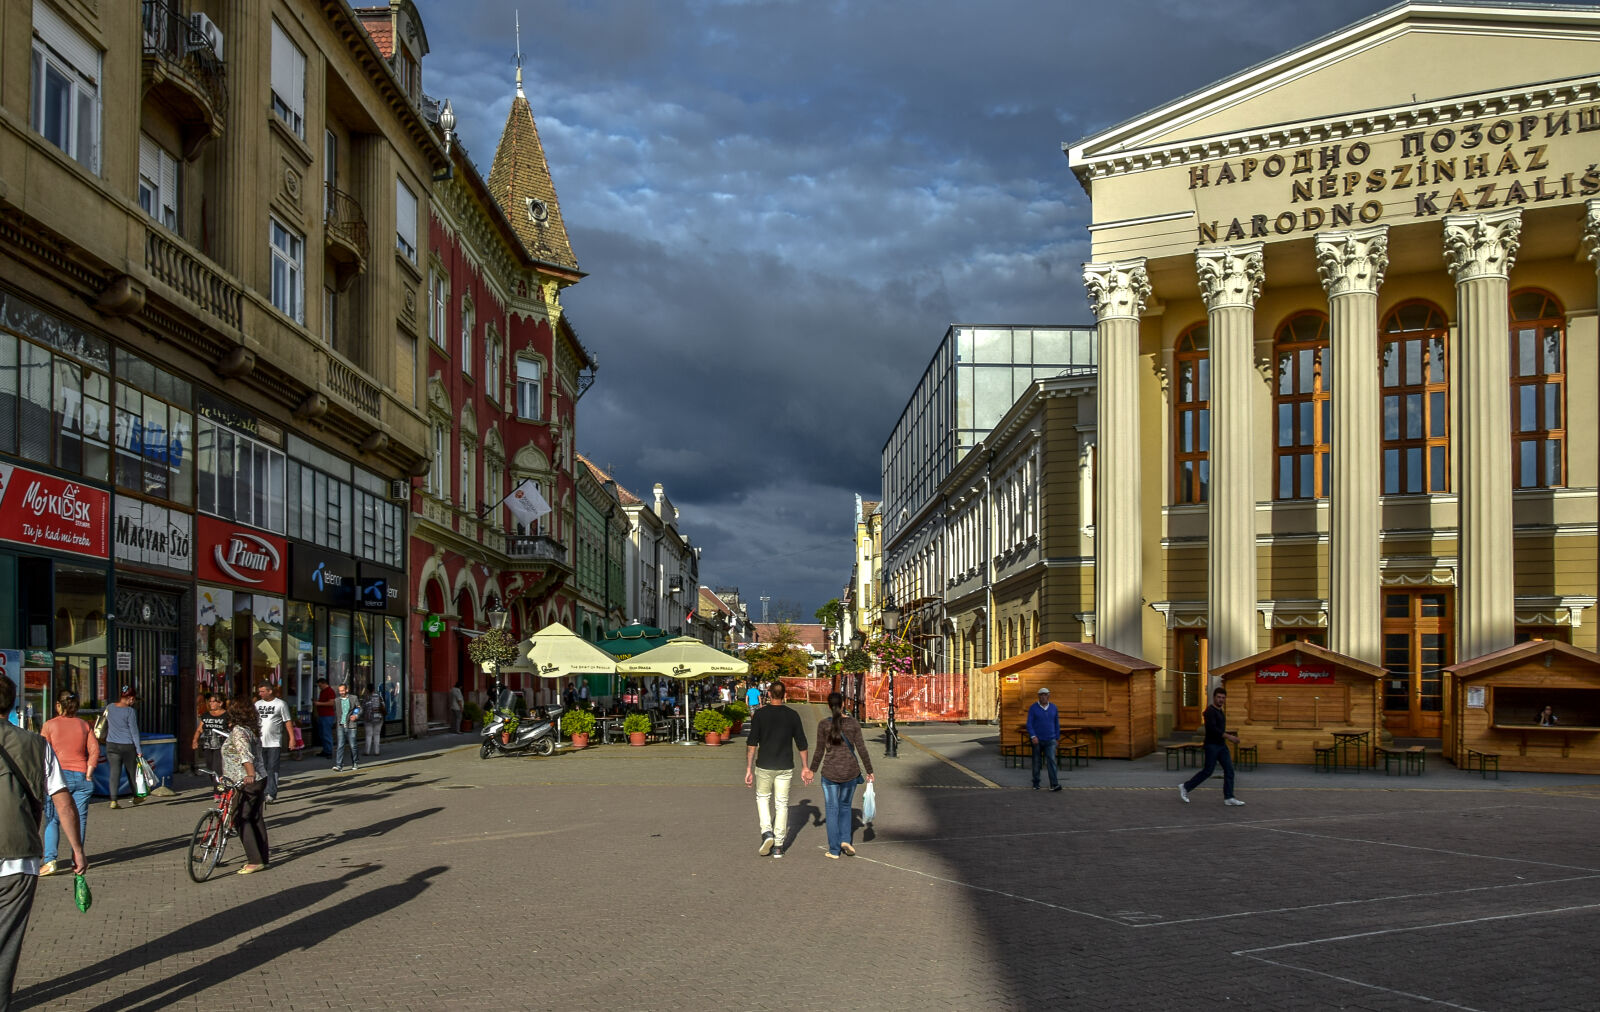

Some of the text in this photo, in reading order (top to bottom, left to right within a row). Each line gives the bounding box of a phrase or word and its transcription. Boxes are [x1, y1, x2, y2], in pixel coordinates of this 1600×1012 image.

[1188, 141, 1370, 189] НАРОДНО
[1291, 144, 1549, 203] NÉPSZÍNHÁZ
[1198, 200, 1384, 245] NARODNO
[22, 523, 34, 536] Tu
[45, 526, 60, 541] kad
[61, 532, 72, 543] mi
[72, 532, 91, 547] treba
